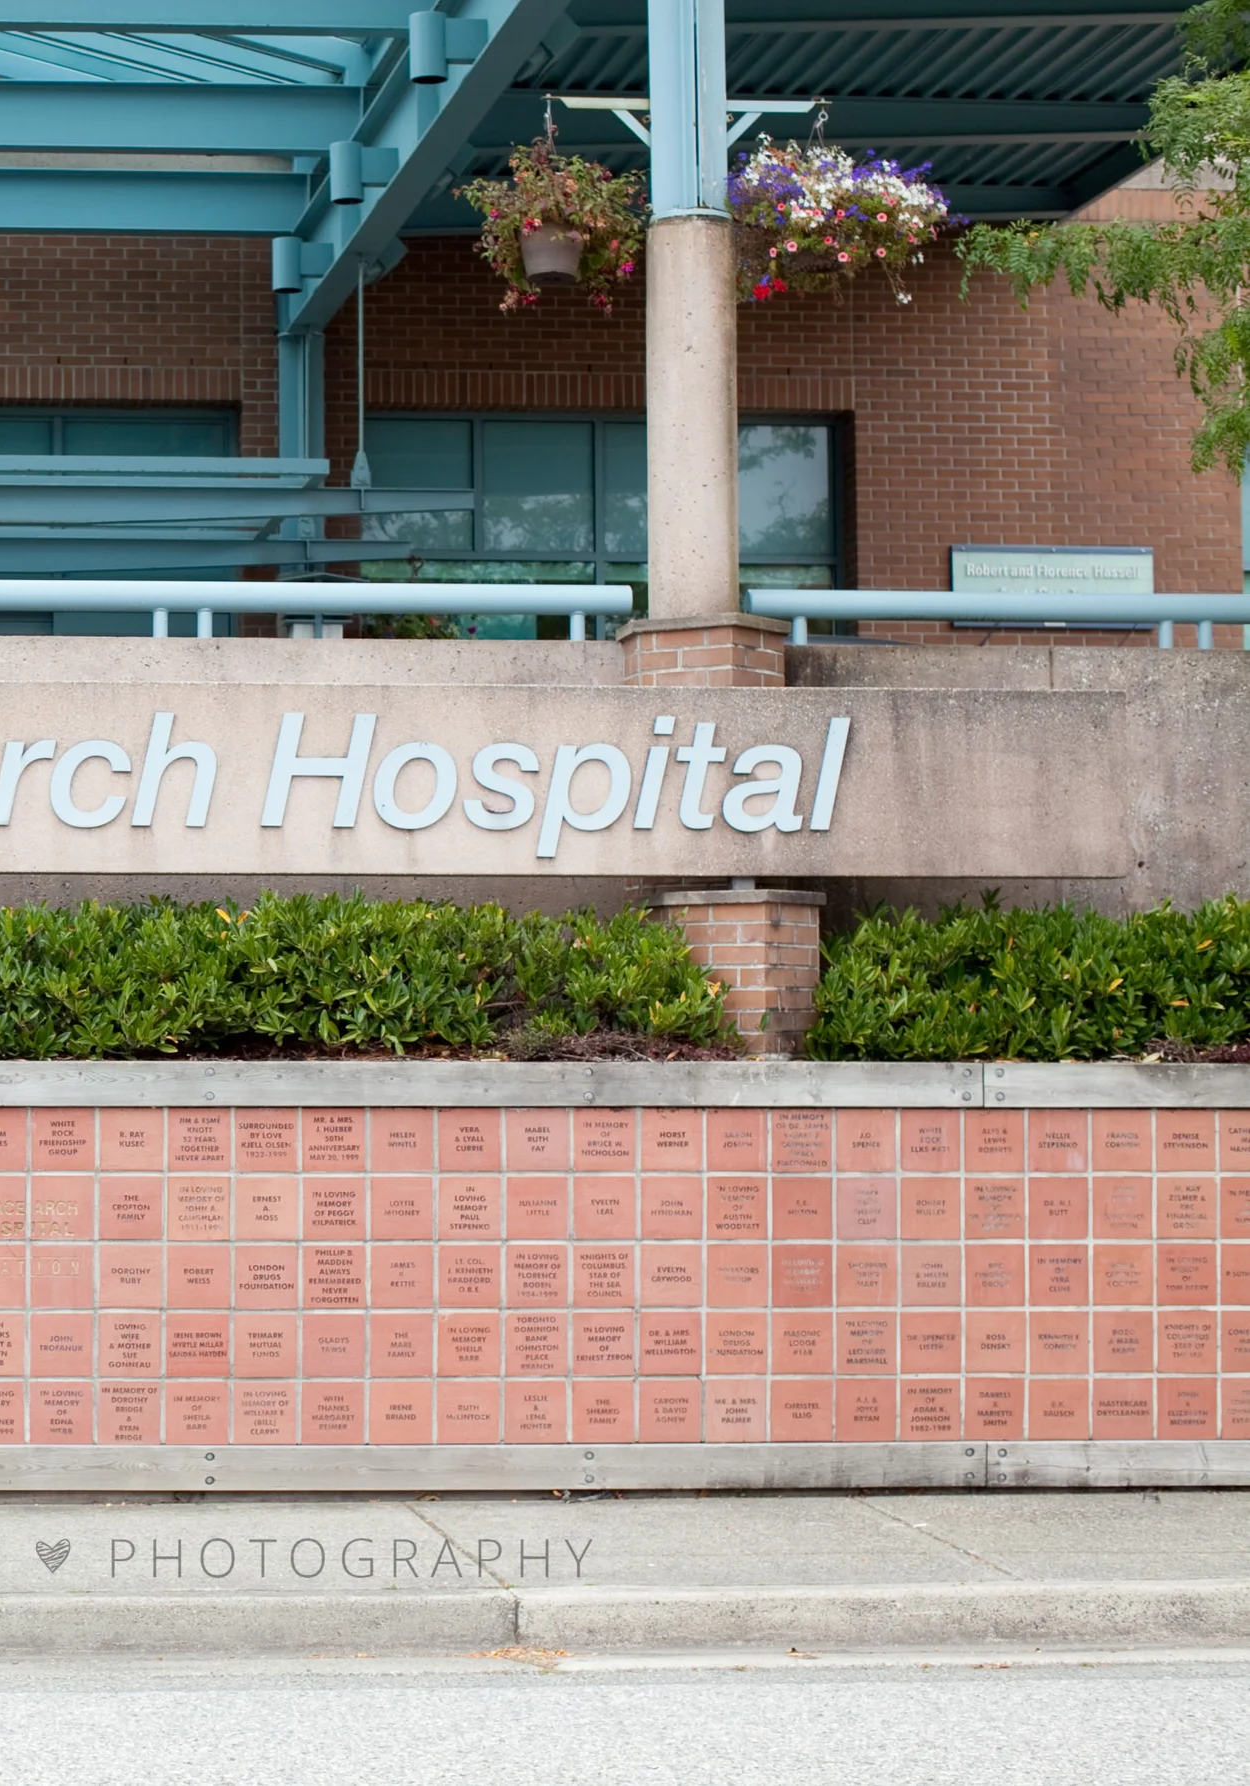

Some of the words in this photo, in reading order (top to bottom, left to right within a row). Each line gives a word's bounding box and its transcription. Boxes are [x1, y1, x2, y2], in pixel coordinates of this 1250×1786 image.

[965, 563, 1009, 578] Robert
[1011, 564, 1034, 578] and
[1036, 564, 1091, 579] Florence
[260, 711, 852, 859] Hospital
[34, 1200, 79, 1215] ARCH
